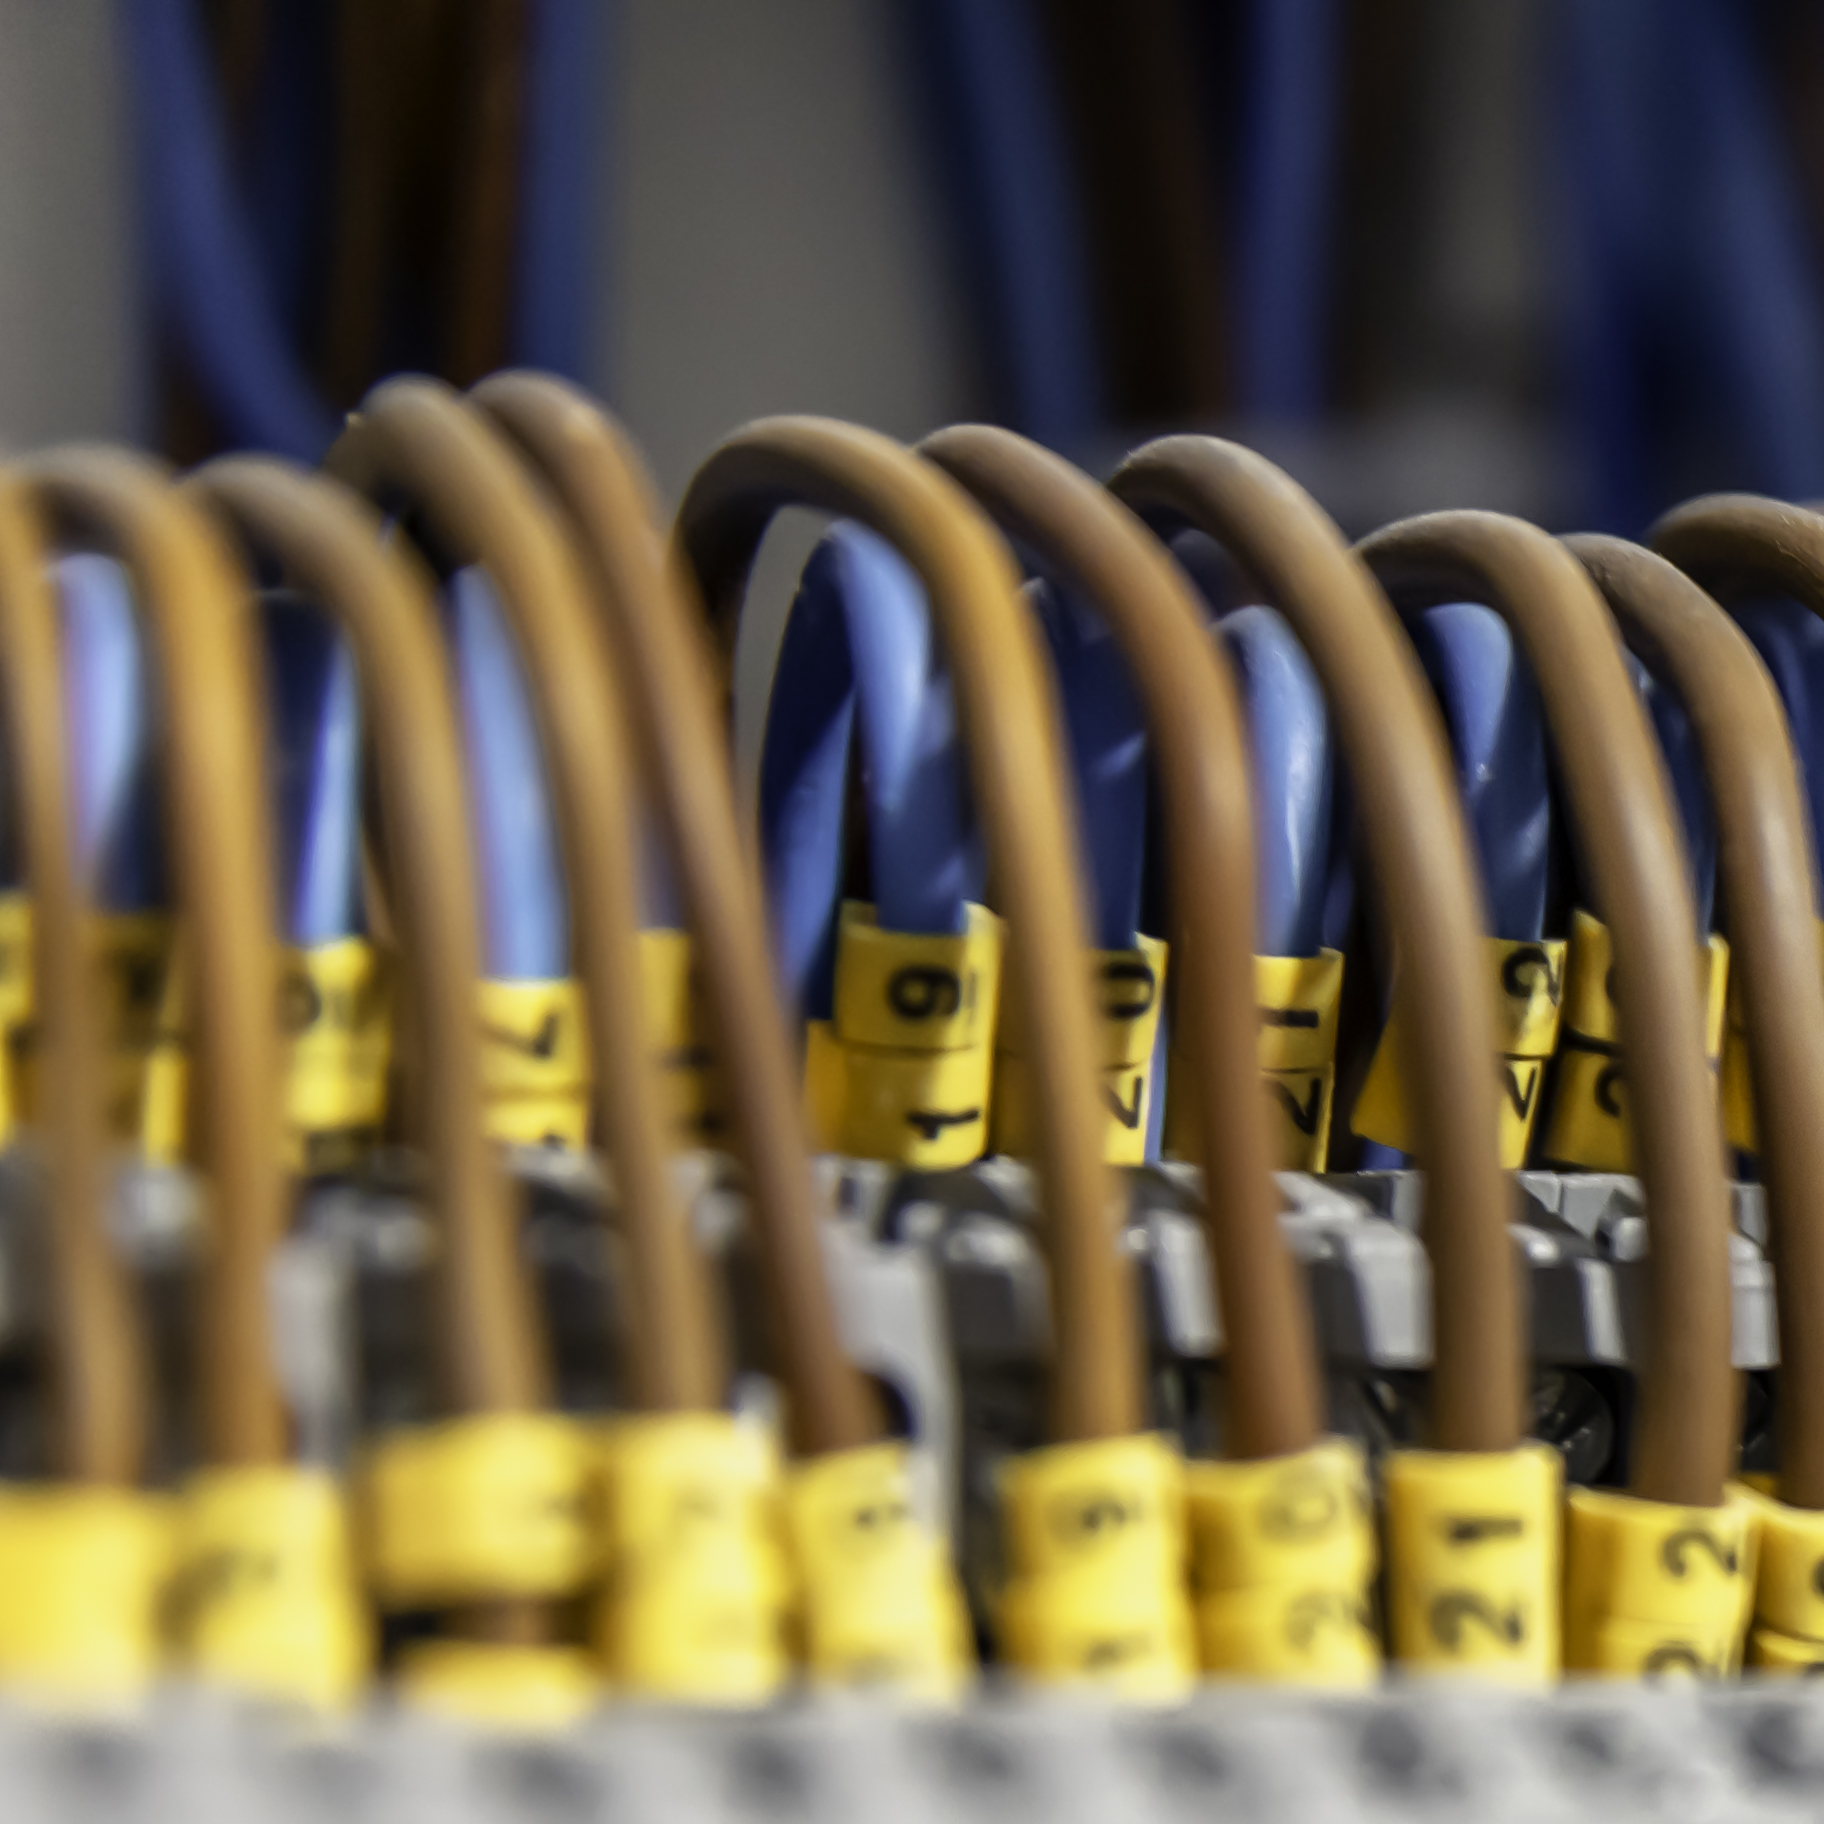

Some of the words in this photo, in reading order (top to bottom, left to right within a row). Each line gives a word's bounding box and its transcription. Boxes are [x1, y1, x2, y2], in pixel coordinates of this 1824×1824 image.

[886, 963, 980, 1142] 19
[1428, 1514, 1524, 1654] 21
[1640, 1528, 1740, 1690] 22
